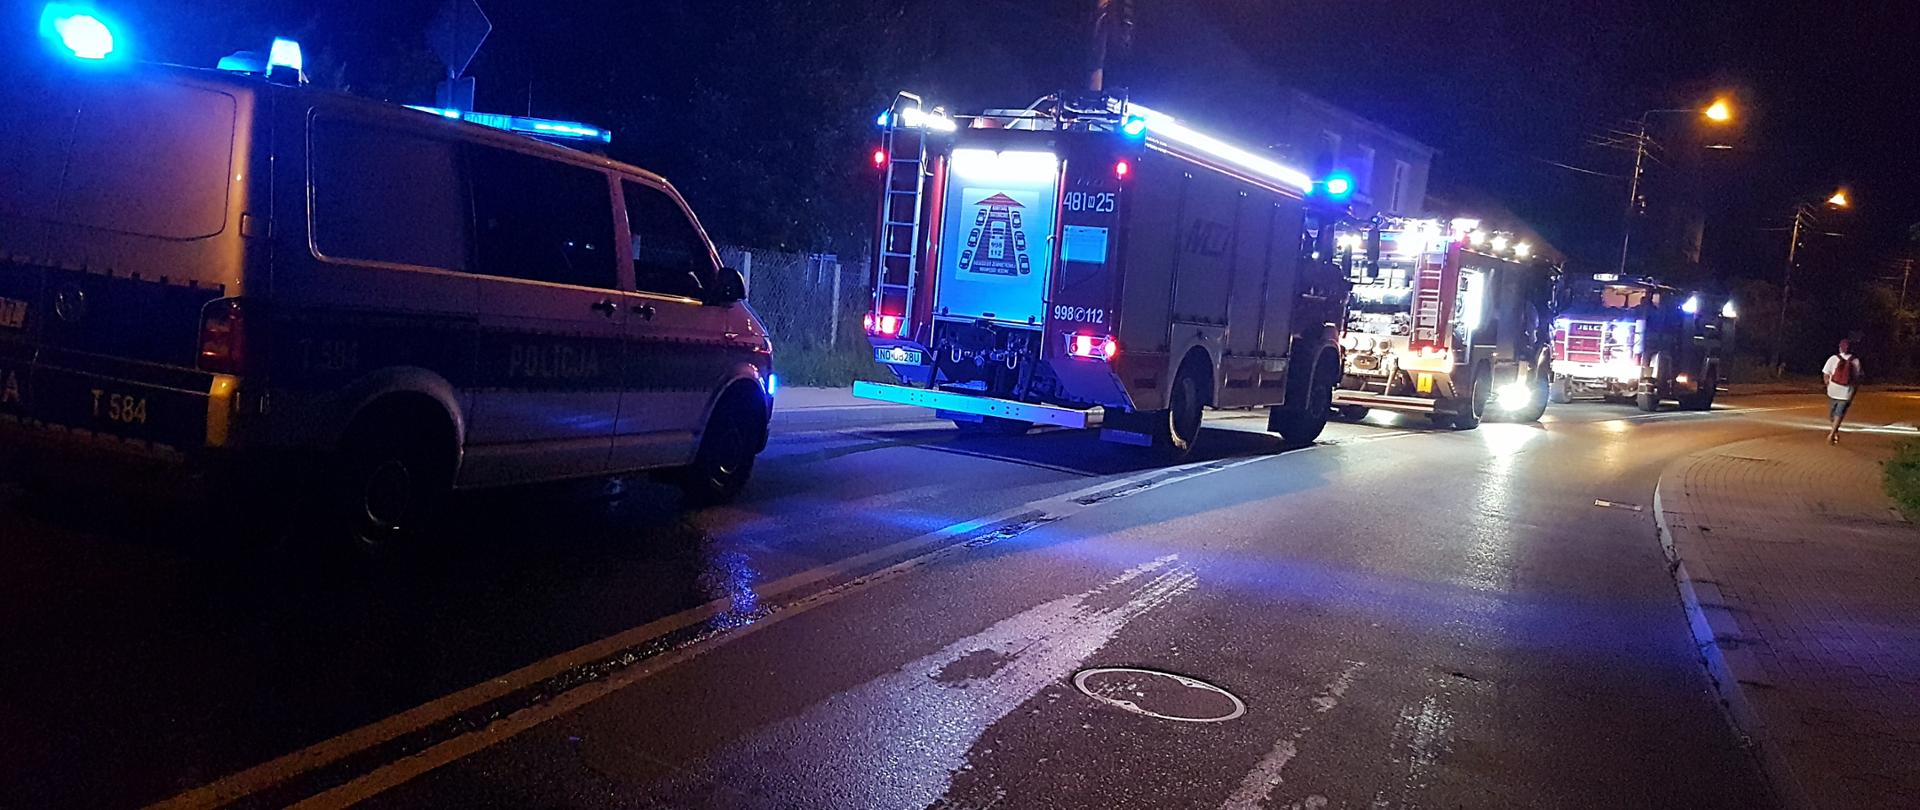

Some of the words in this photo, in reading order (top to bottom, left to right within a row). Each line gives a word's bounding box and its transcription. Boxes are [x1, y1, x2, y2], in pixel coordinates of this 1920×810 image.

[1054, 305, 1074, 320] 998
[1086, 308, 1104, 323] 112
[508, 341, 600, 379] POLICJA
[90, 387, 105, 416] T
[109, 392, 147, 424] 584
